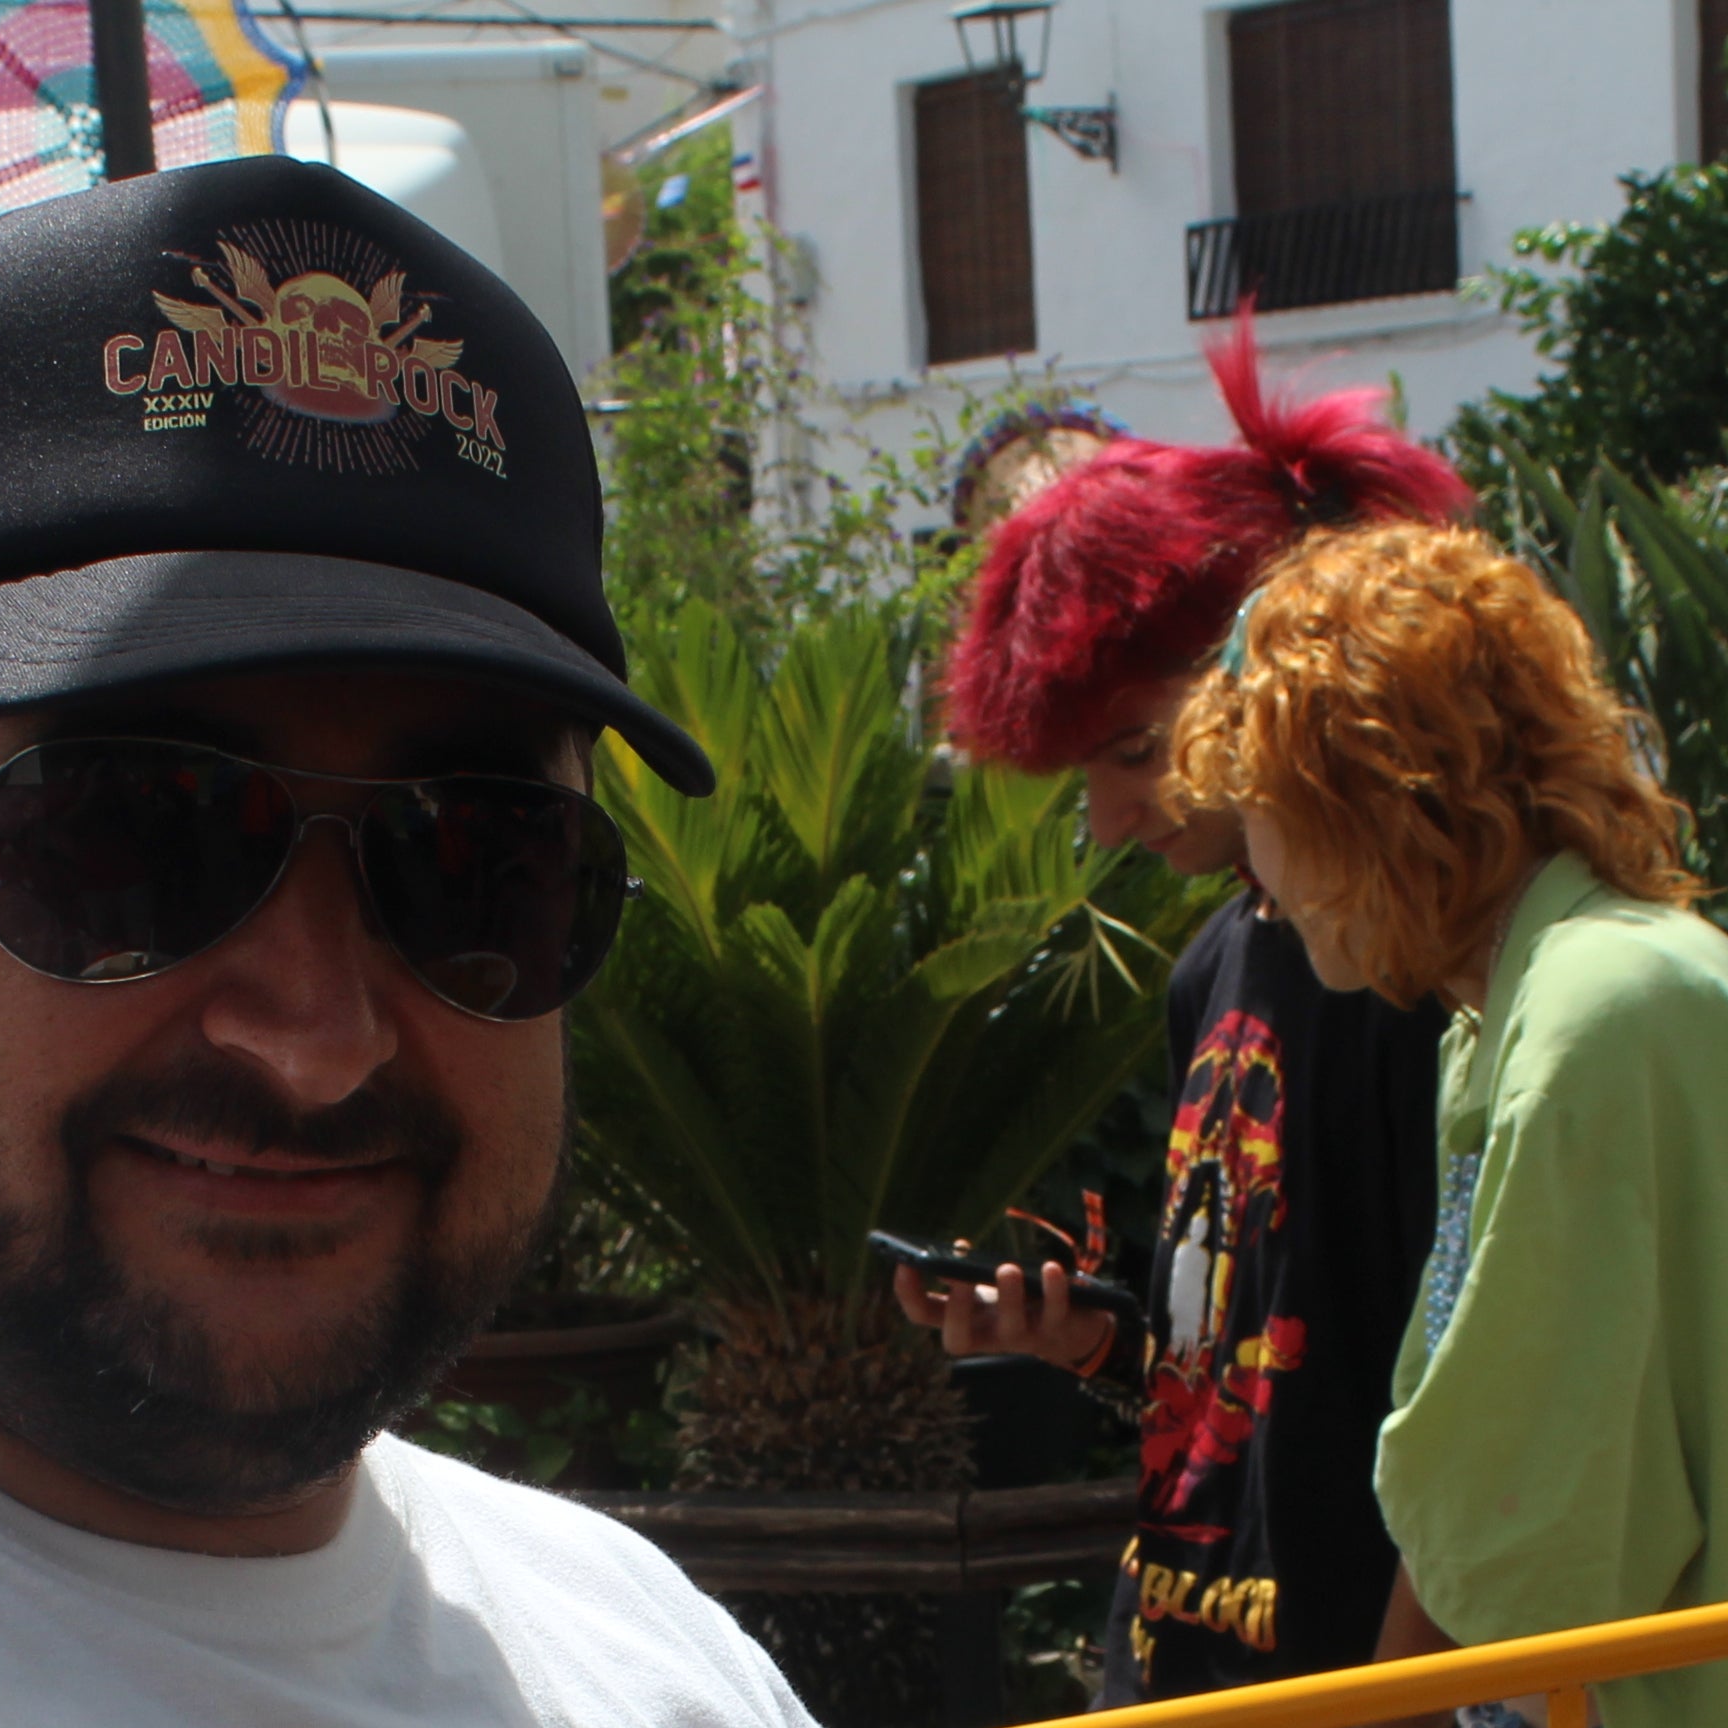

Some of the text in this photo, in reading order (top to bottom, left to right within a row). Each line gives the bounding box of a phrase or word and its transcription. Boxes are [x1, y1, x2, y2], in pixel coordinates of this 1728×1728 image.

[104, 327, 506, 451] CANDIL ROCK
[143, 392, 214, 415] XXXIV
[455, 434, 507, 479] 2022
